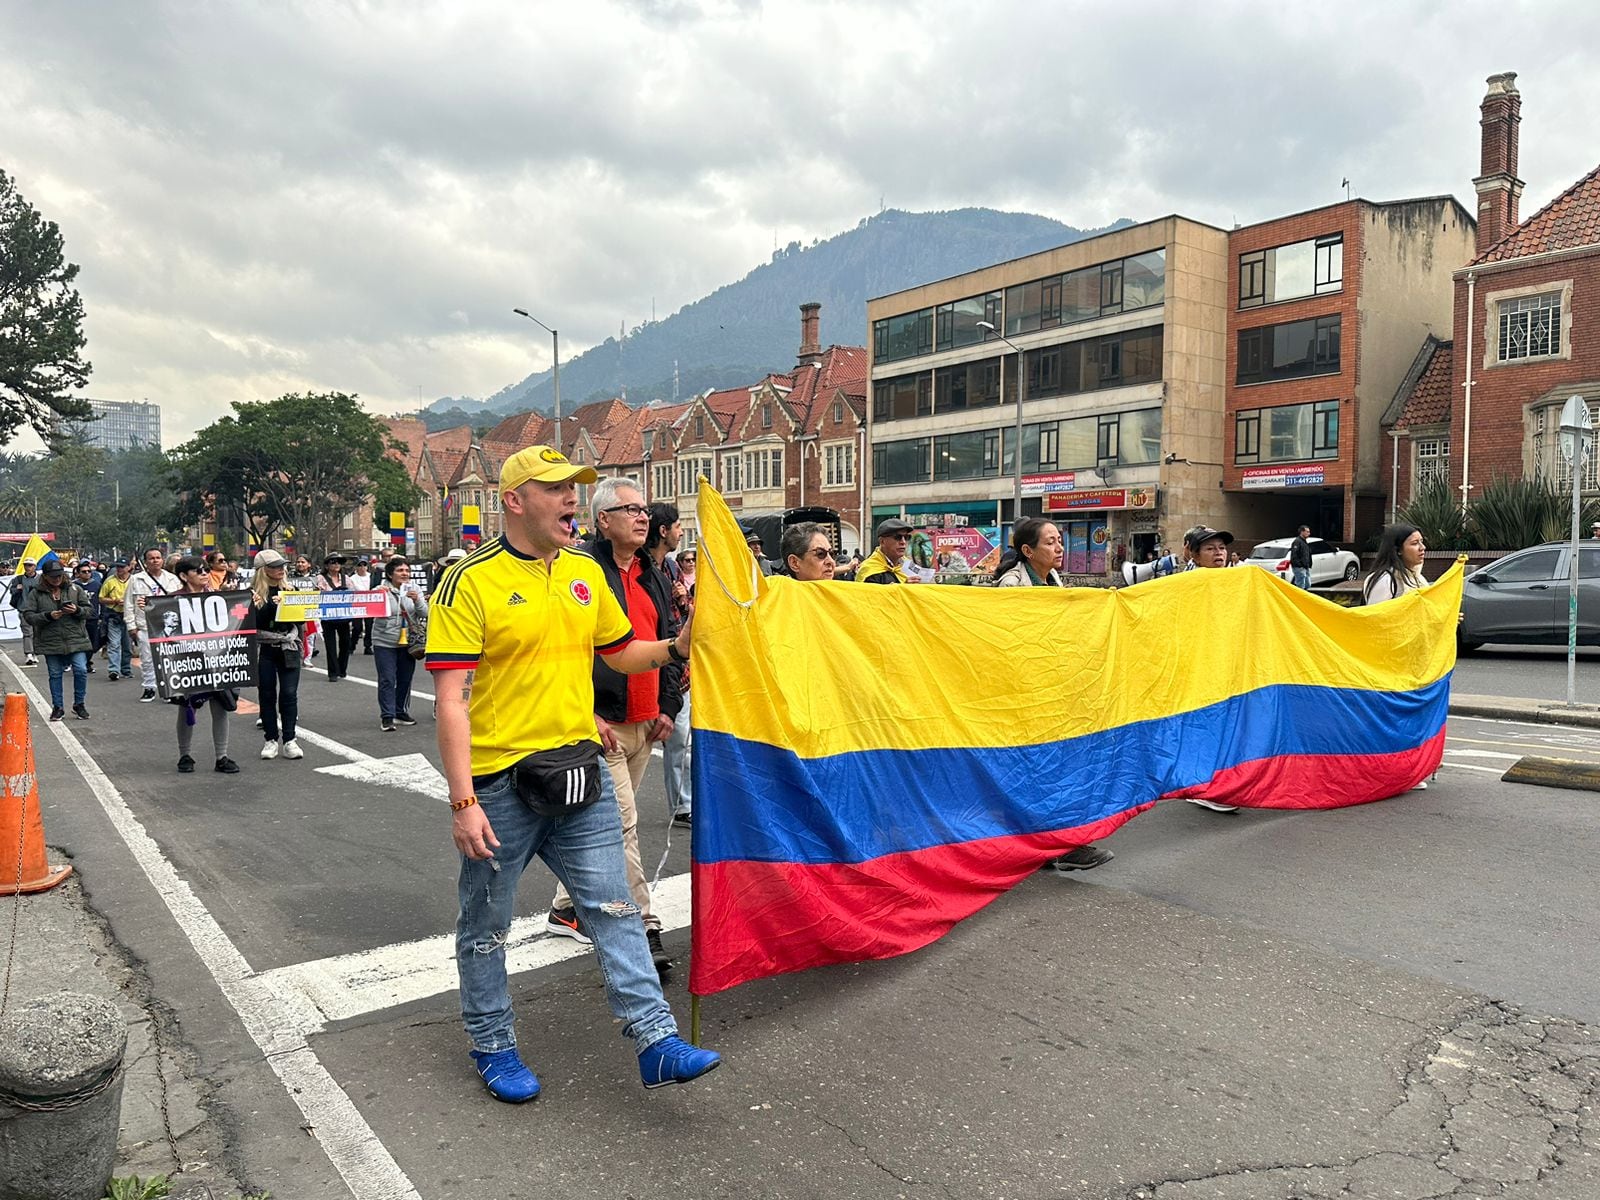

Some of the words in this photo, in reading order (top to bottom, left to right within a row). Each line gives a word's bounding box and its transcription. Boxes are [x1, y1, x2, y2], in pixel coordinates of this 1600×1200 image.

[178, 595, 229, 634] NO
[160, 639, 206, 656] Atornillados
[208, 639, 218, 650] en
[218, 637, 226, 648] el
[228, 635, 248, 651] poder.
[163, 656, 202, 674] Puestos
[204, 651, 250, 670] heredados.
[169, 667, 250, 690] Corrupción.
